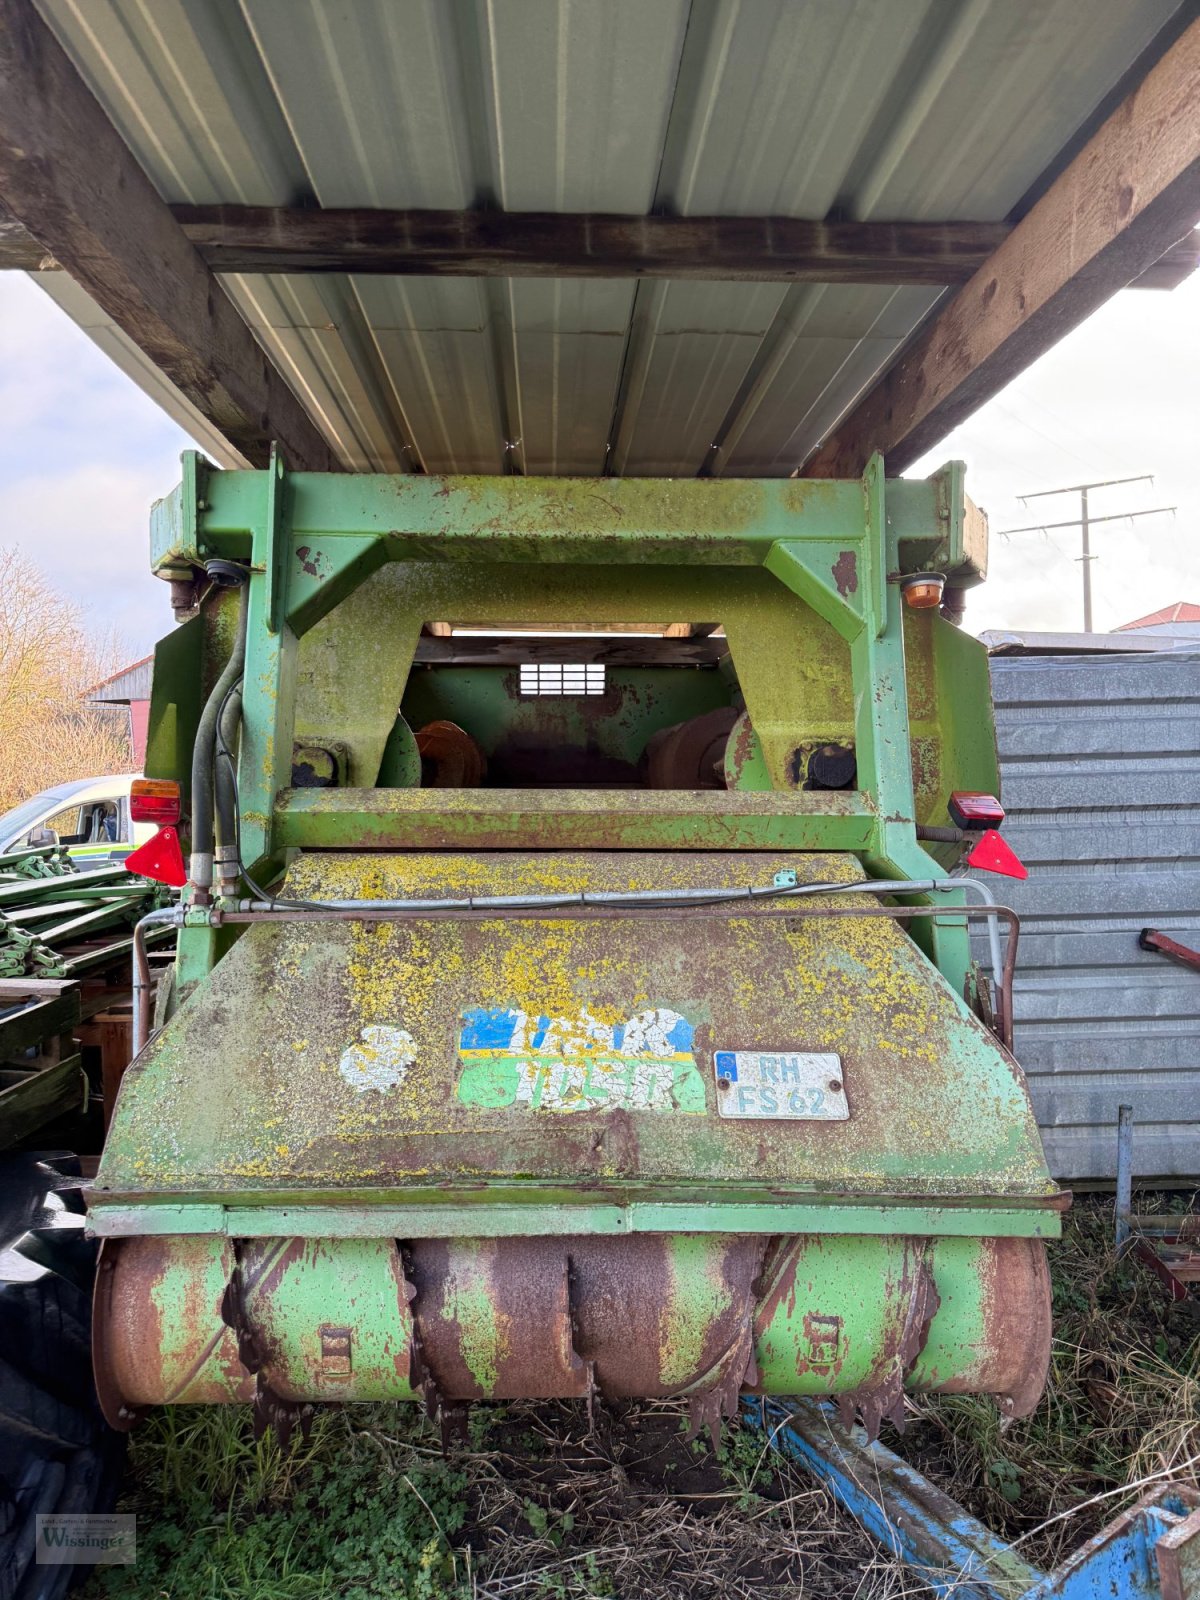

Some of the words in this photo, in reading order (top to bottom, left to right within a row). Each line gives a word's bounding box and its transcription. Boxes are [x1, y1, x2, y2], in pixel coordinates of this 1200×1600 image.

[724, 1071, 732, 1080] D
[759, 1056, 800, 1083] RH
[737, 1086, 779, 1114] FS
[788, 1087, 828, 1114] 62
